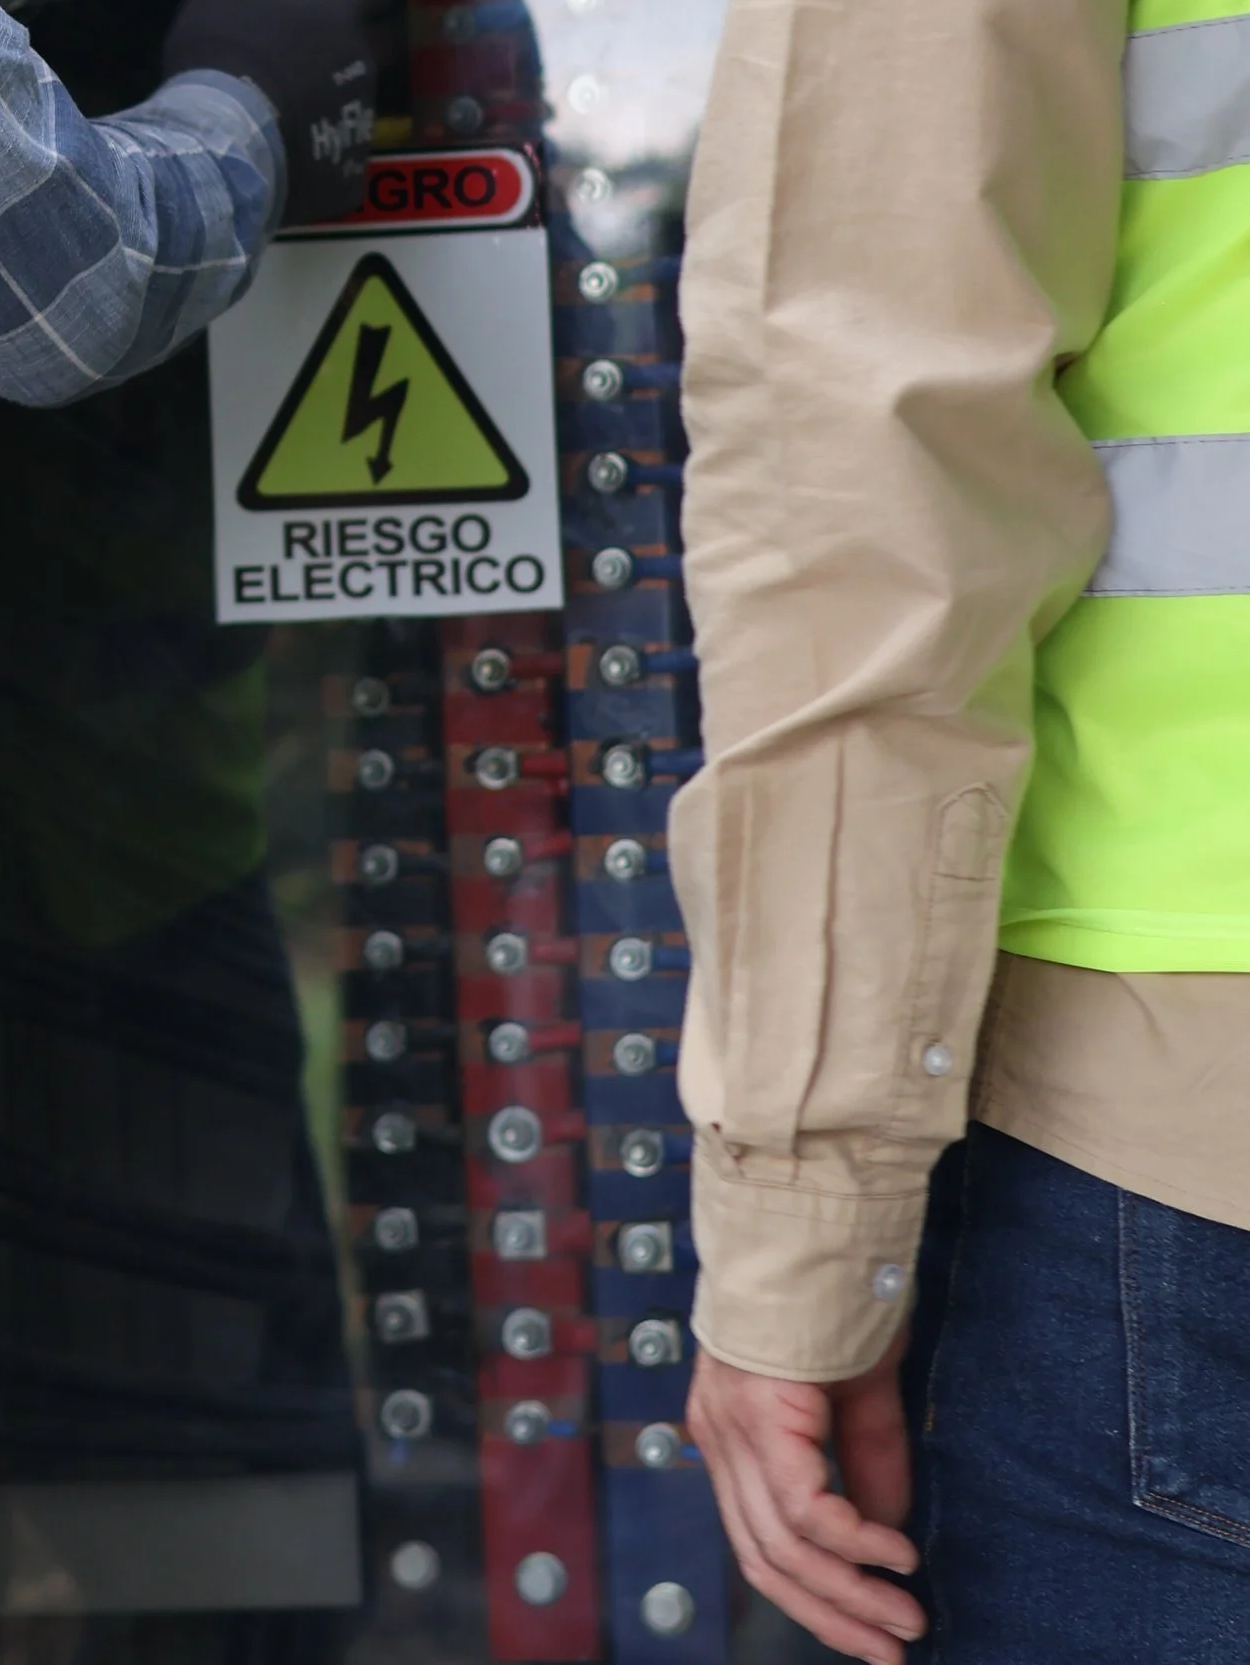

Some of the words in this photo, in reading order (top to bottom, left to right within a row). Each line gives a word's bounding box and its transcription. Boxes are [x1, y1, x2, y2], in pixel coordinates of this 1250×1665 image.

[356, 164, 496, 213] GRO
[283, 514, 491, 559] RIESGO
[234, 554, 546, 604] ELECTRICO
